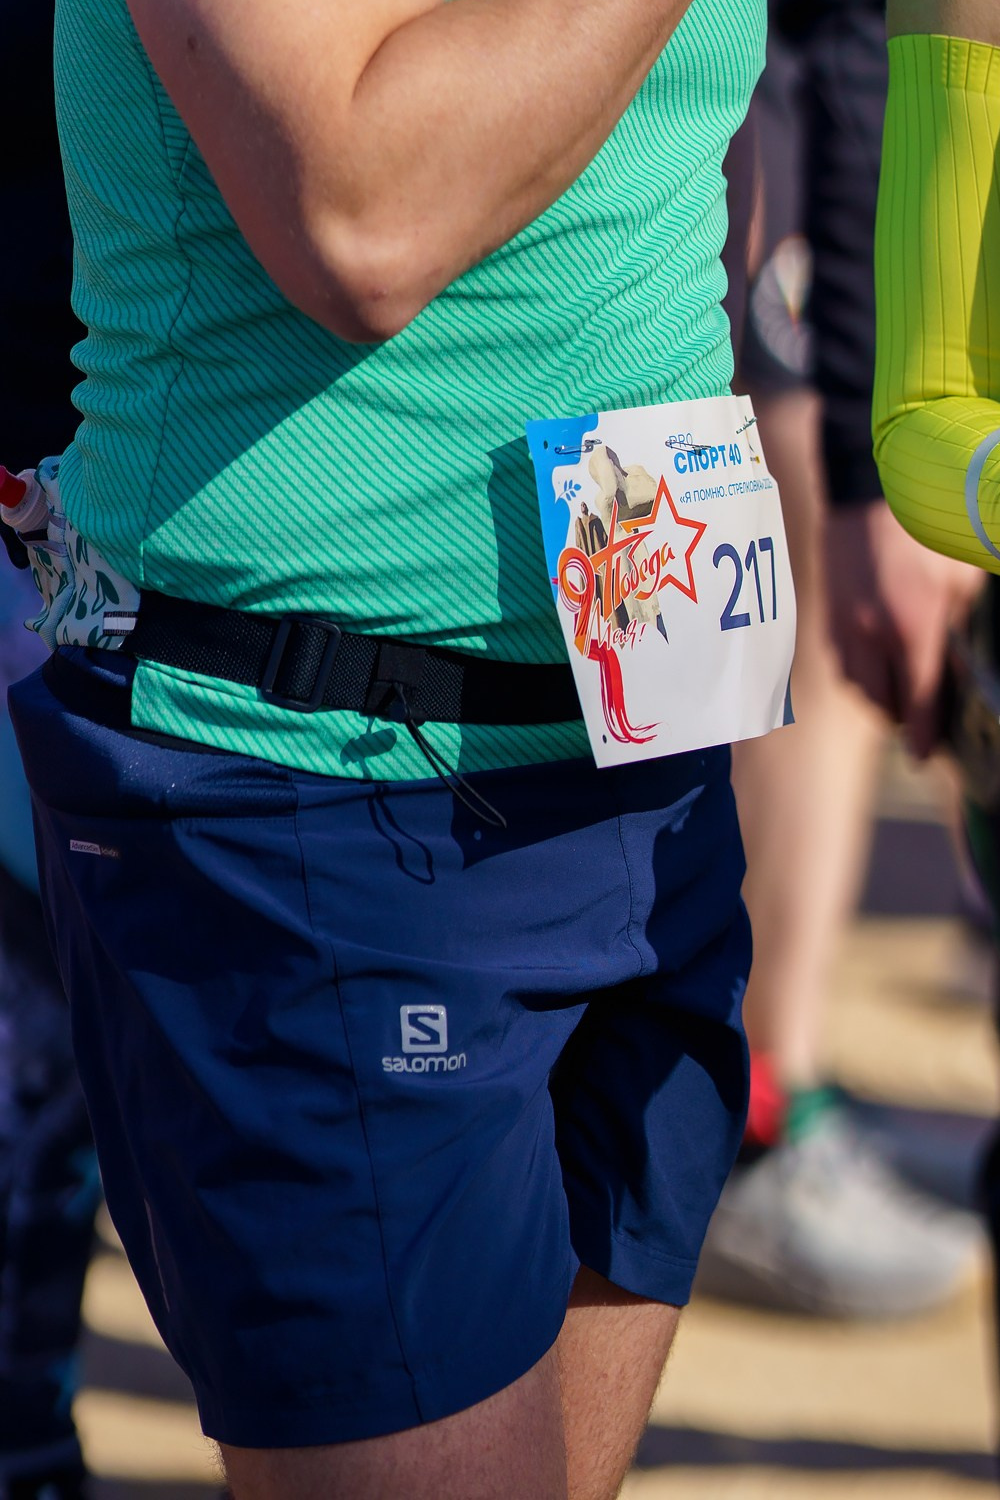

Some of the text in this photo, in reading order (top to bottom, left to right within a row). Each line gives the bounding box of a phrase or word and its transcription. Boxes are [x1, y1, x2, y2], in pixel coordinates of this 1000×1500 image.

[673, 443, 742, 474] СПОРТ 40
[693, 485, 728, 501] ПОМНЮ.
[711, 536, 778, 632] 217
